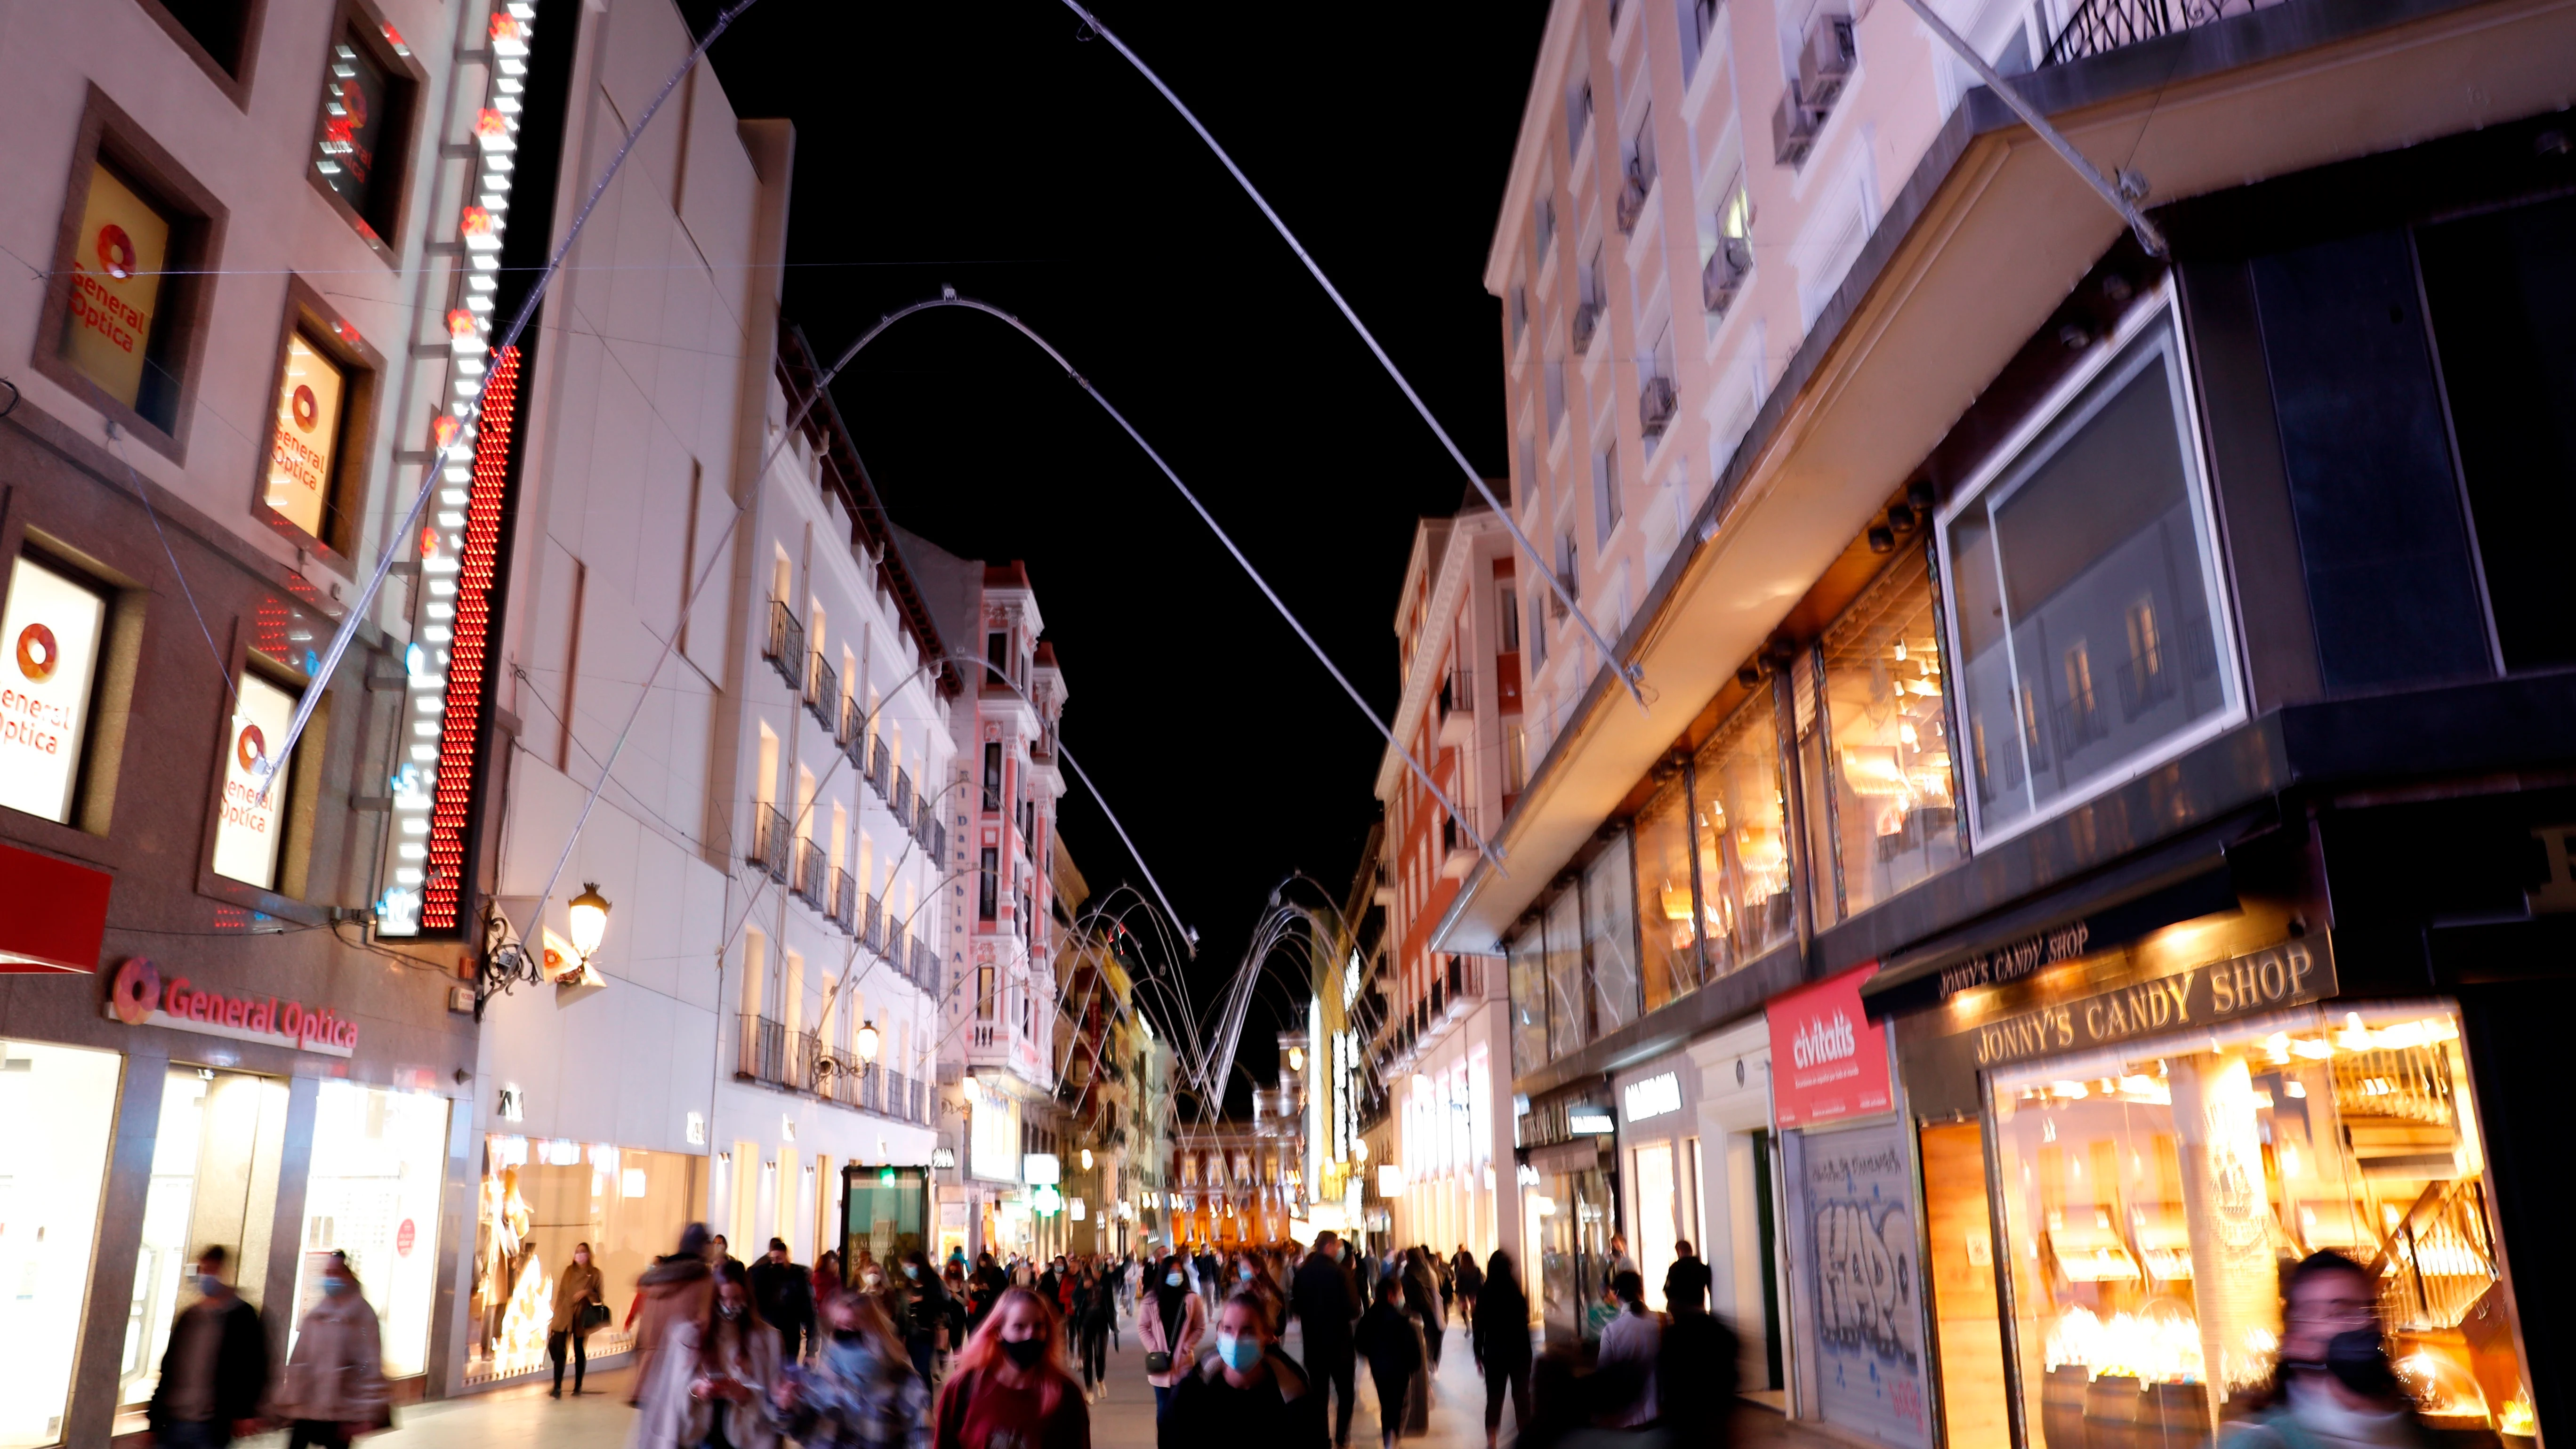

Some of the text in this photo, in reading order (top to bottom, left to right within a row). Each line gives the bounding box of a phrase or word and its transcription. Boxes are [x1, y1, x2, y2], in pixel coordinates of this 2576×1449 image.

[71, 262, 145, 335] General
[71, 291, 134, 353] Optica
[271, 445, 317, 491] Optica
[228, 781, 274, 812] eneral
[955, 815, 968, 934] Danubio
[1939, 921, 2089, 1000] JONNY'S CANDY SHOP
[166, 977, 359, 1050] General Optica
[1794, 1010, 1856, 1070] civitatis
[1978, 943, 2314, 1066] JONNY'S CANDY SHOP
